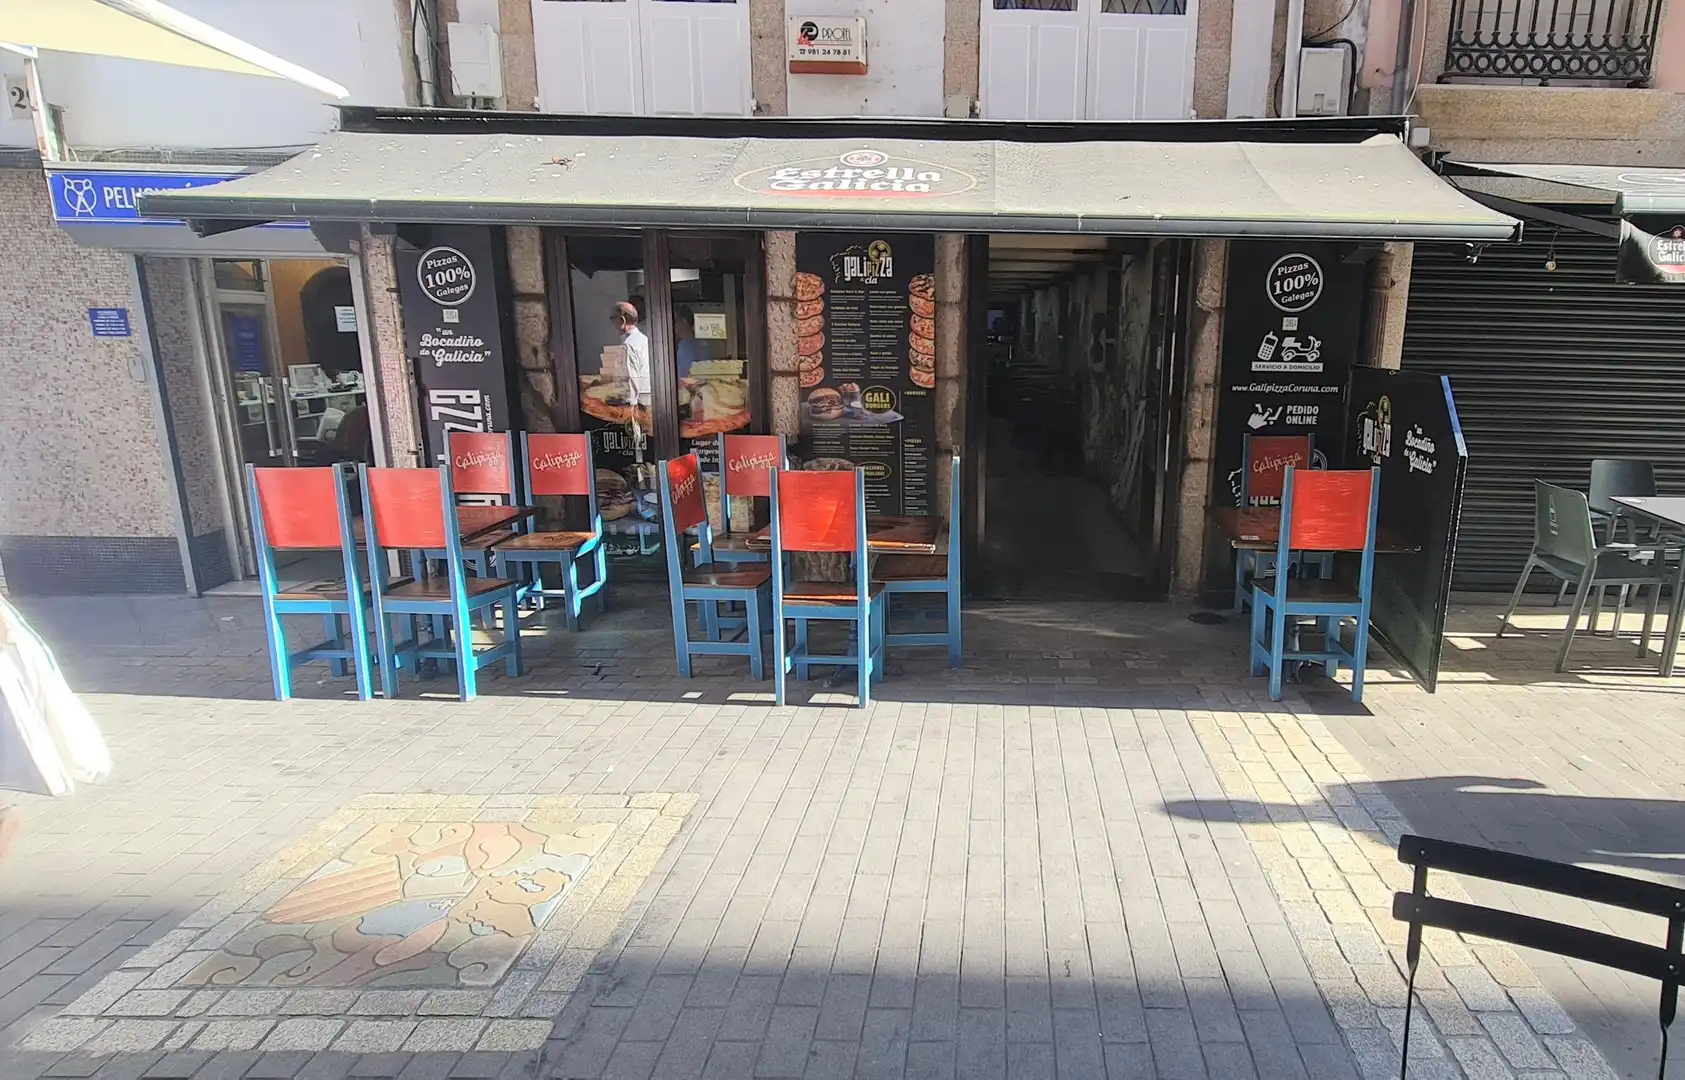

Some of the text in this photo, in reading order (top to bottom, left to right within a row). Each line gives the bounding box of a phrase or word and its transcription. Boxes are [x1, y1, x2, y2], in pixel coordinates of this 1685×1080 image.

[767, 167, 943, 182] Estrella
[770, 178, 932, 192] Galicia
[426, 255, 458, 269] Pizzas
[1277, 262, 1309, 276] Pizzas
[425, 266, 470, 288] 100%
[1273, 272, 1319, 295] 100%
[436, 283, 469, 297] Galegas
[1281, 290, 1314, 304] Galegas
[420, 334, 484, 347] Bocadiño
[1232, 383, 1338, 394] www.GalipizzaCoruna.com
[865, 392, 889, 402] GALI
[1286, 405, 1319, 415] PEDIDO
[1285, 415, 1317, 425] ONLINE
[692, 440, 711, 449] Lugar
